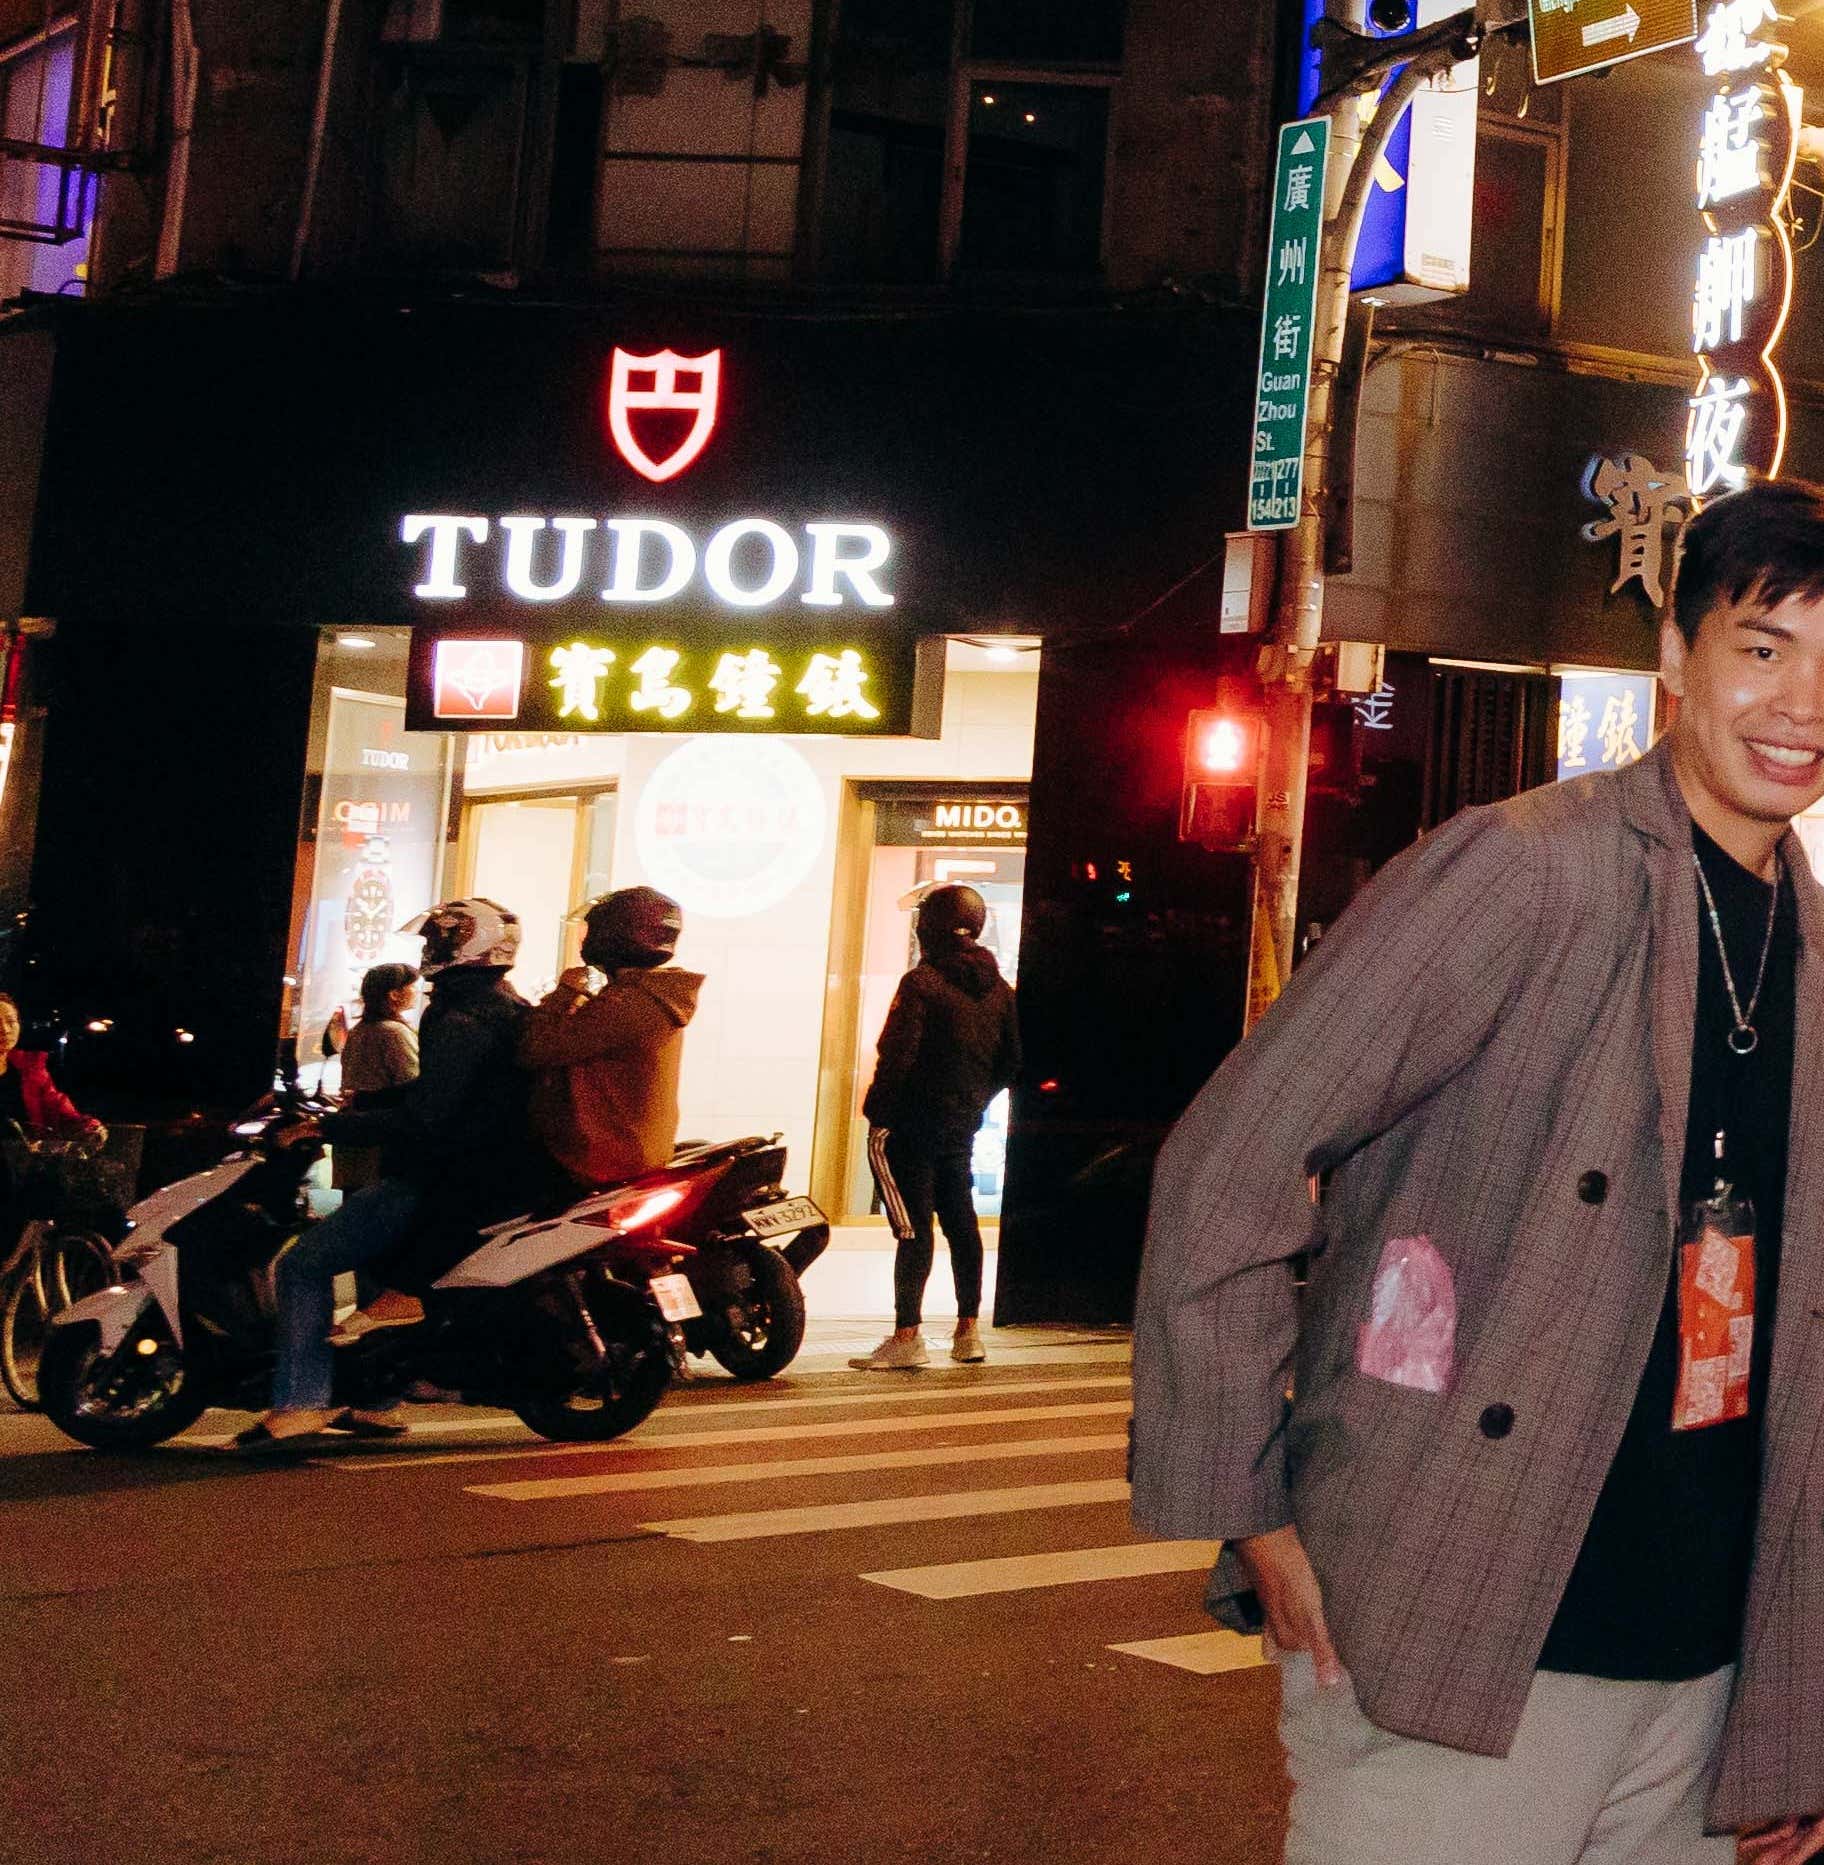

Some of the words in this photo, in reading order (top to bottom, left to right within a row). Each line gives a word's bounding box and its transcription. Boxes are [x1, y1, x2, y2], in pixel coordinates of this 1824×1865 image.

[1273, 165, 1313, 360] 廣州街
[1261, 372, 1300, 393] Guan
[1258, 401, 1297, 422] Zhou
[1256, 431, 1275, 452] St.
[403, 515, 896, 607] TUDOR
[361, 748, 409, 771] TUDOR
[935, 805, 1021, 828] MIDO
